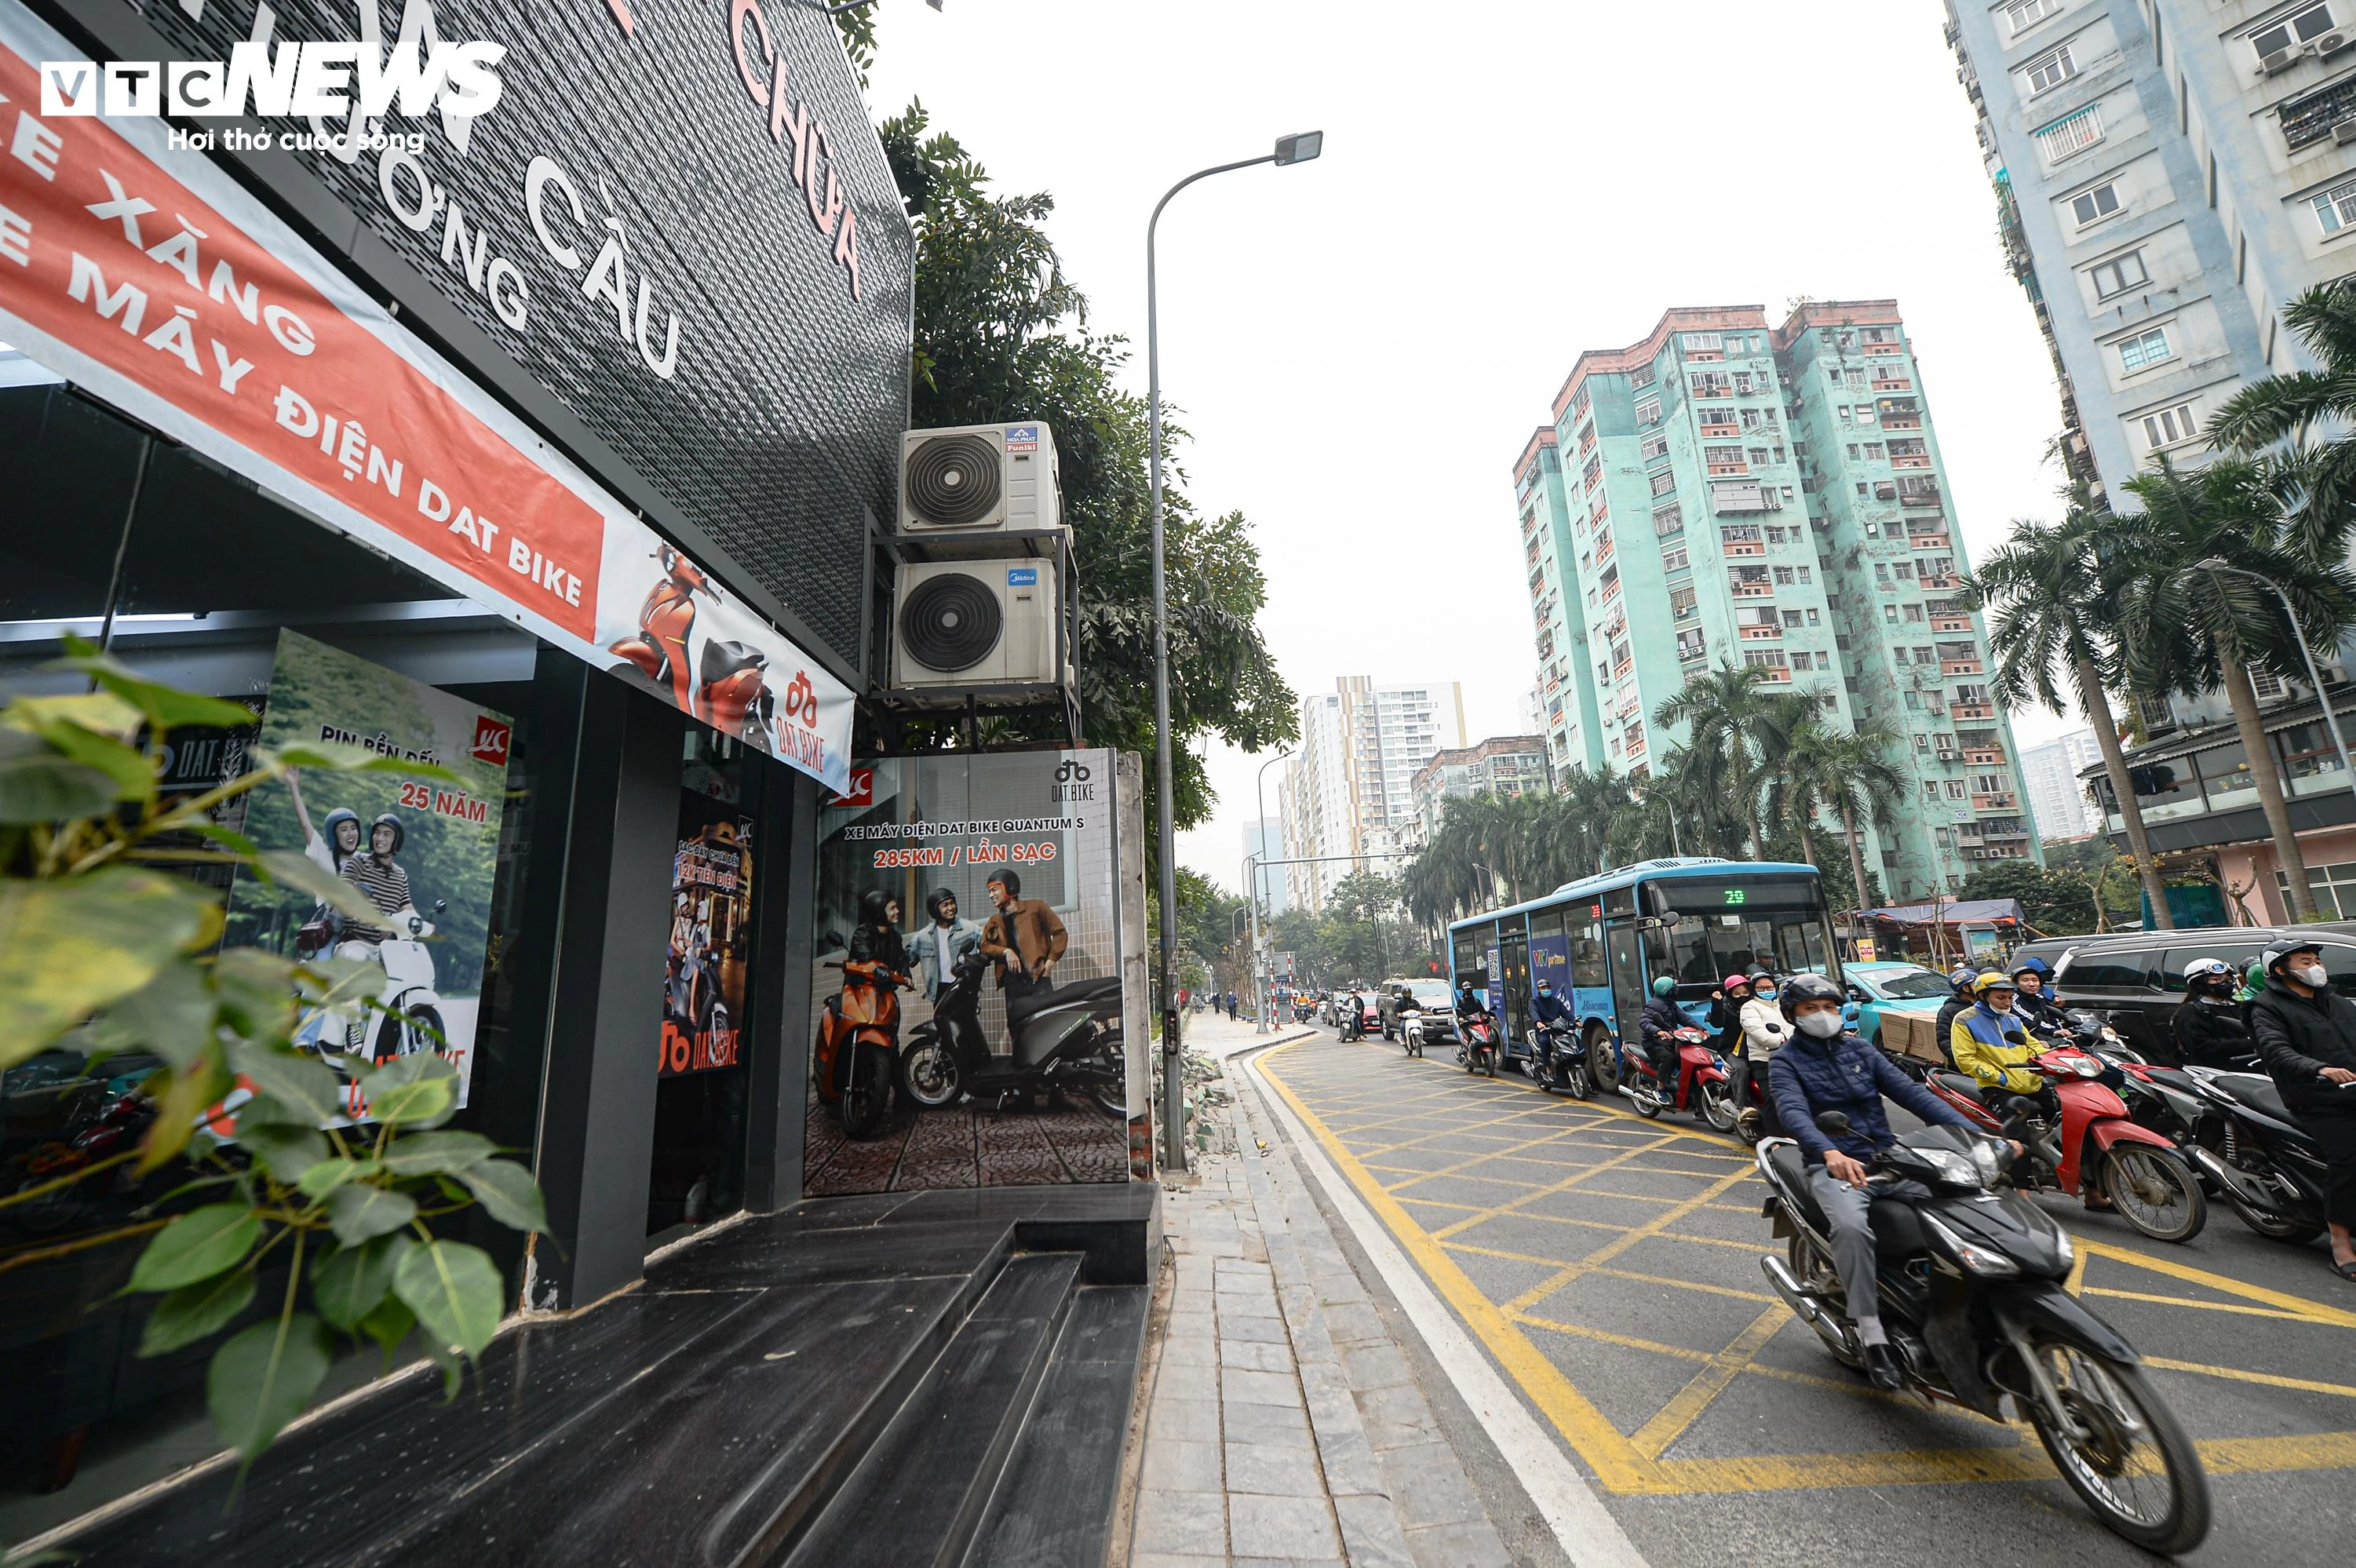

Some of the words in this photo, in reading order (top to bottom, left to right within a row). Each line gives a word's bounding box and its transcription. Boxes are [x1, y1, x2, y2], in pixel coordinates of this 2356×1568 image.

[0, 93, 63, 182] E
[84, 167, 316, 356] XĂNG
[524, 155, 680, 379] CẦU
[67, 251, 255, 396] MÁY
[273, 384, 403, 498] ĐIỆN
[417, 478, 499, 554] DAT
[508, 536, 582, 609] BIKE
[1010, 573, 1035, 582] Midea
[399, 782, 430, 811] 25
[436, 791, 488, 823] NĂM
[1051, 783, 1095, 803] DAT.BIKE
[844, 826, 864, 840] XE
[866, 822, 899, 839] MÁY
[903, 821, 935, 841] ĐIỆN
[939, 822, 965, 837] DAT
[968, 820, 998, 834] BIKE
[1002, 818, 1072, 833] QUANTUM
[1076, 817, 1085, 829] S
[873, 847, 943, 869] 285KM
[966, 837, 1008, 865] LẦN
[1011, 842, 1056, 866] SẠC
[1724, 890, 1745, 903] 29
